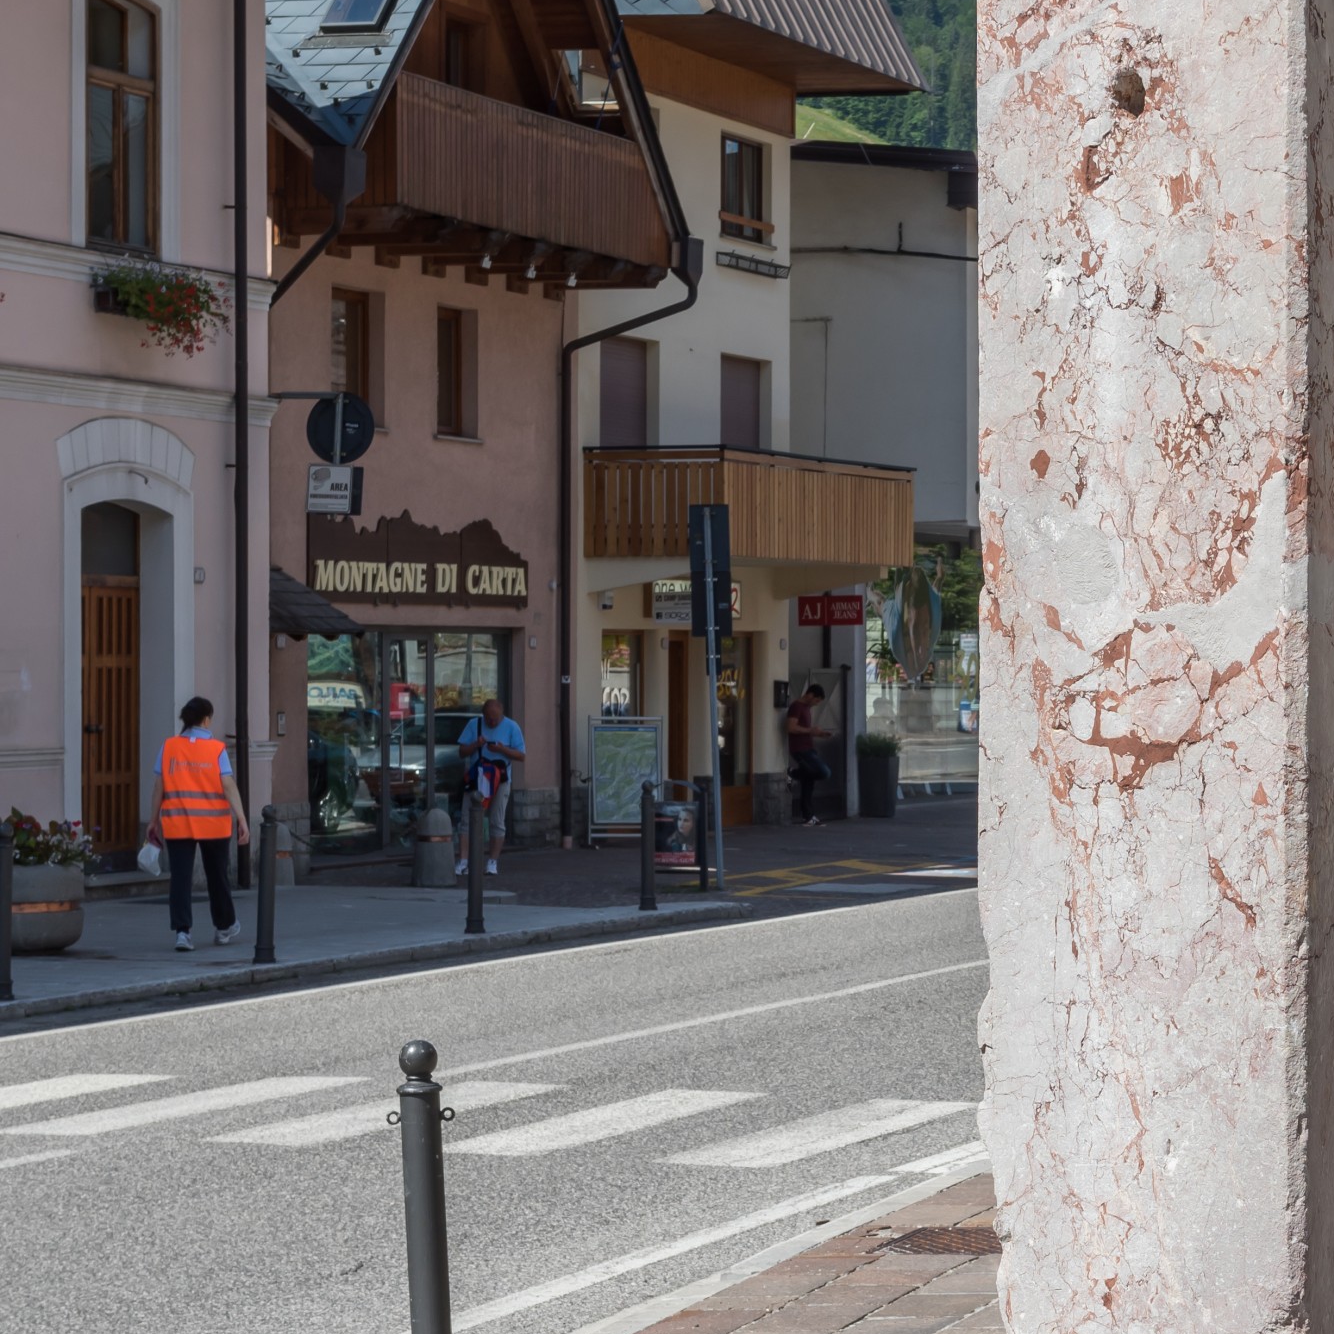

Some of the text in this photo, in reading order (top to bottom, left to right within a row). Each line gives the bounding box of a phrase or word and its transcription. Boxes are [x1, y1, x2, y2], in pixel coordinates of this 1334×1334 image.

[330, 482, 348, 492] AREA
[314, 559, 527, 596] MONTAGNE DI CARTA
[801, 603, 822, 620] AJ
[830, 602, 860, 611] ARMANI
[832, 610, 858, 620] JEANS
